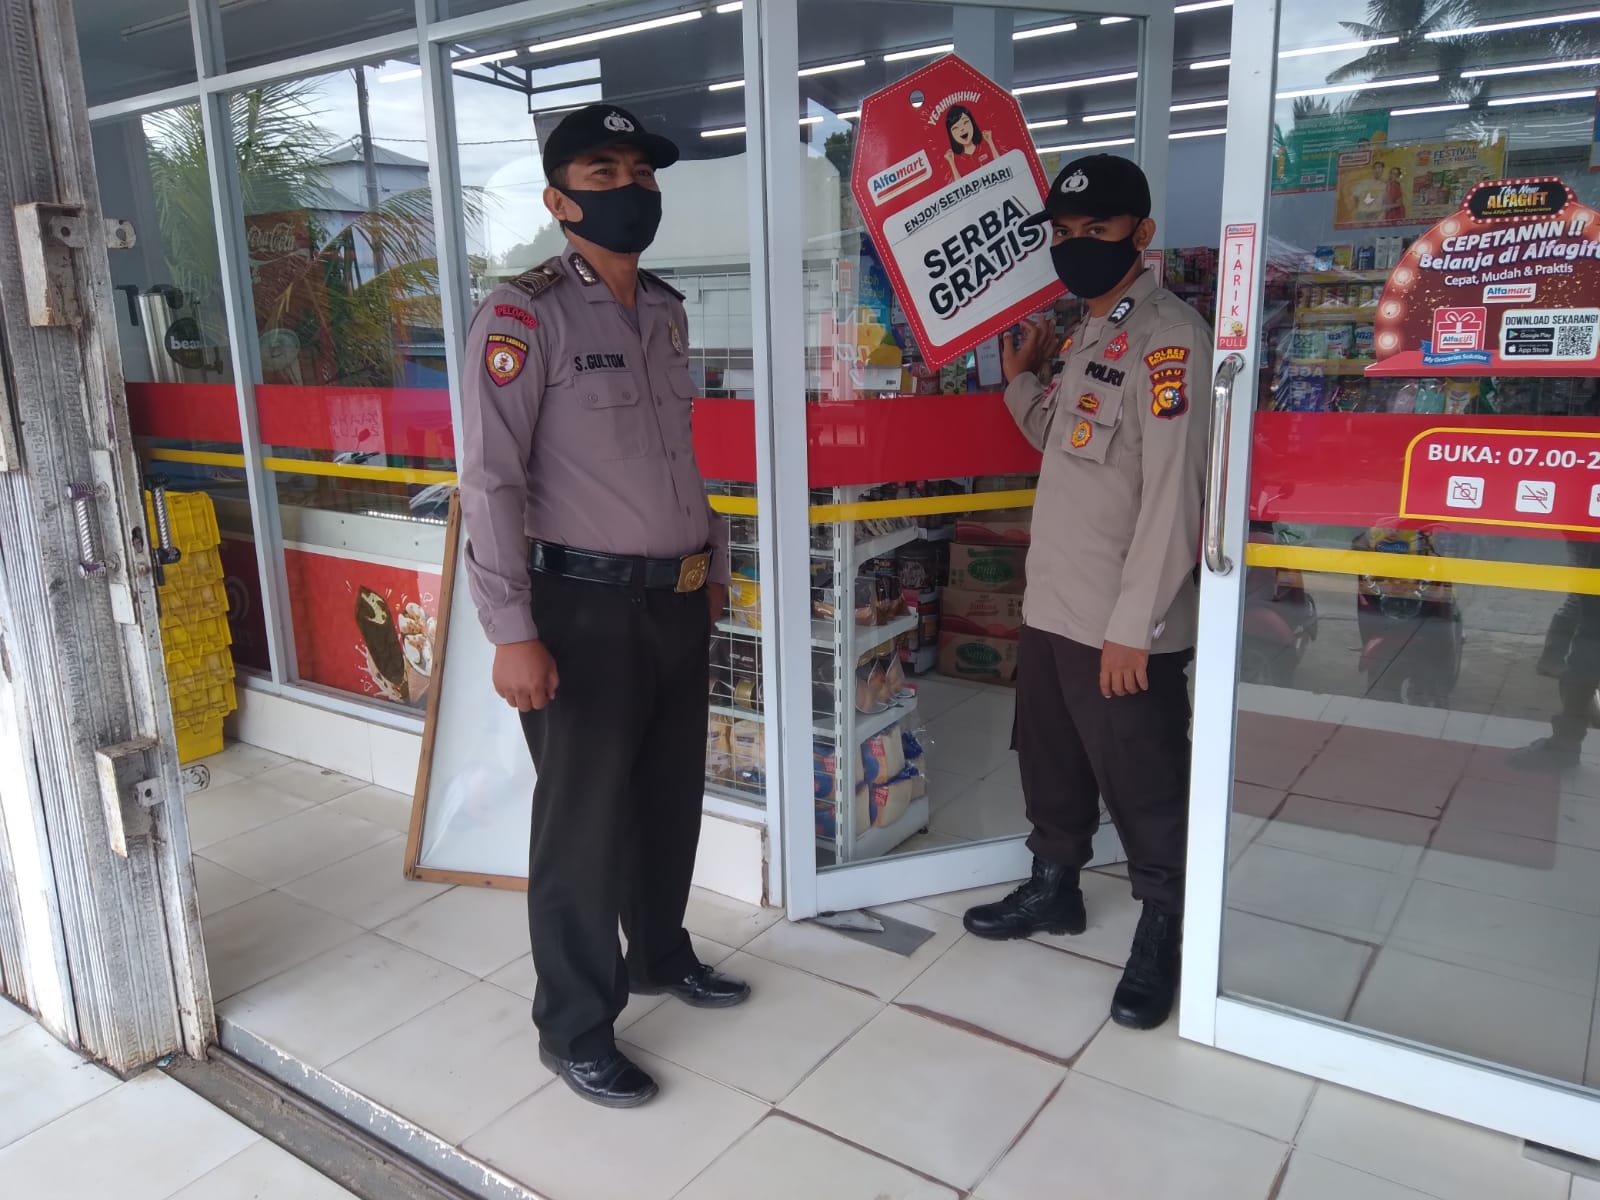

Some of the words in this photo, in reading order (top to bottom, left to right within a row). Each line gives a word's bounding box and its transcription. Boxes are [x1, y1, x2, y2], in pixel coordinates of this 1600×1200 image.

[872, 156, 925, 193] Alfamart
[904, 202, 939, 234] ENJOY
[938, 179, 983, 211] SETIAP
[982, 167, 1013, 188] HARI
[1486, 191, 1549, 209] ALFAGIFT
[924, 195, 1024, 279] SERBA
[1442, 222, 1566, 253] CEPETANNN
[929, 224, 1043, 316] GRATIS
[1419, 253, 1494, 272] Belanja
[1499, 246, 1518, 264] di
[1444, 275, 1480, 287] Cepat,
[1481, 268, 1522, 283] Mudah
[1523, 267, 1533, 277] &
[1535, 262, 1574, 276] Praktis
[1487, 286, 1532, 296] Alfamart
[1505, 315, 1550, 326] DOWNLOAD
[1552, 314, 1599, 325] SEKARANG!
[1220, 337, 1244, 348] PULL
[1085, 361, 1126, 387] POLRI
[1428, 444, 1501, 465] BUKA:
